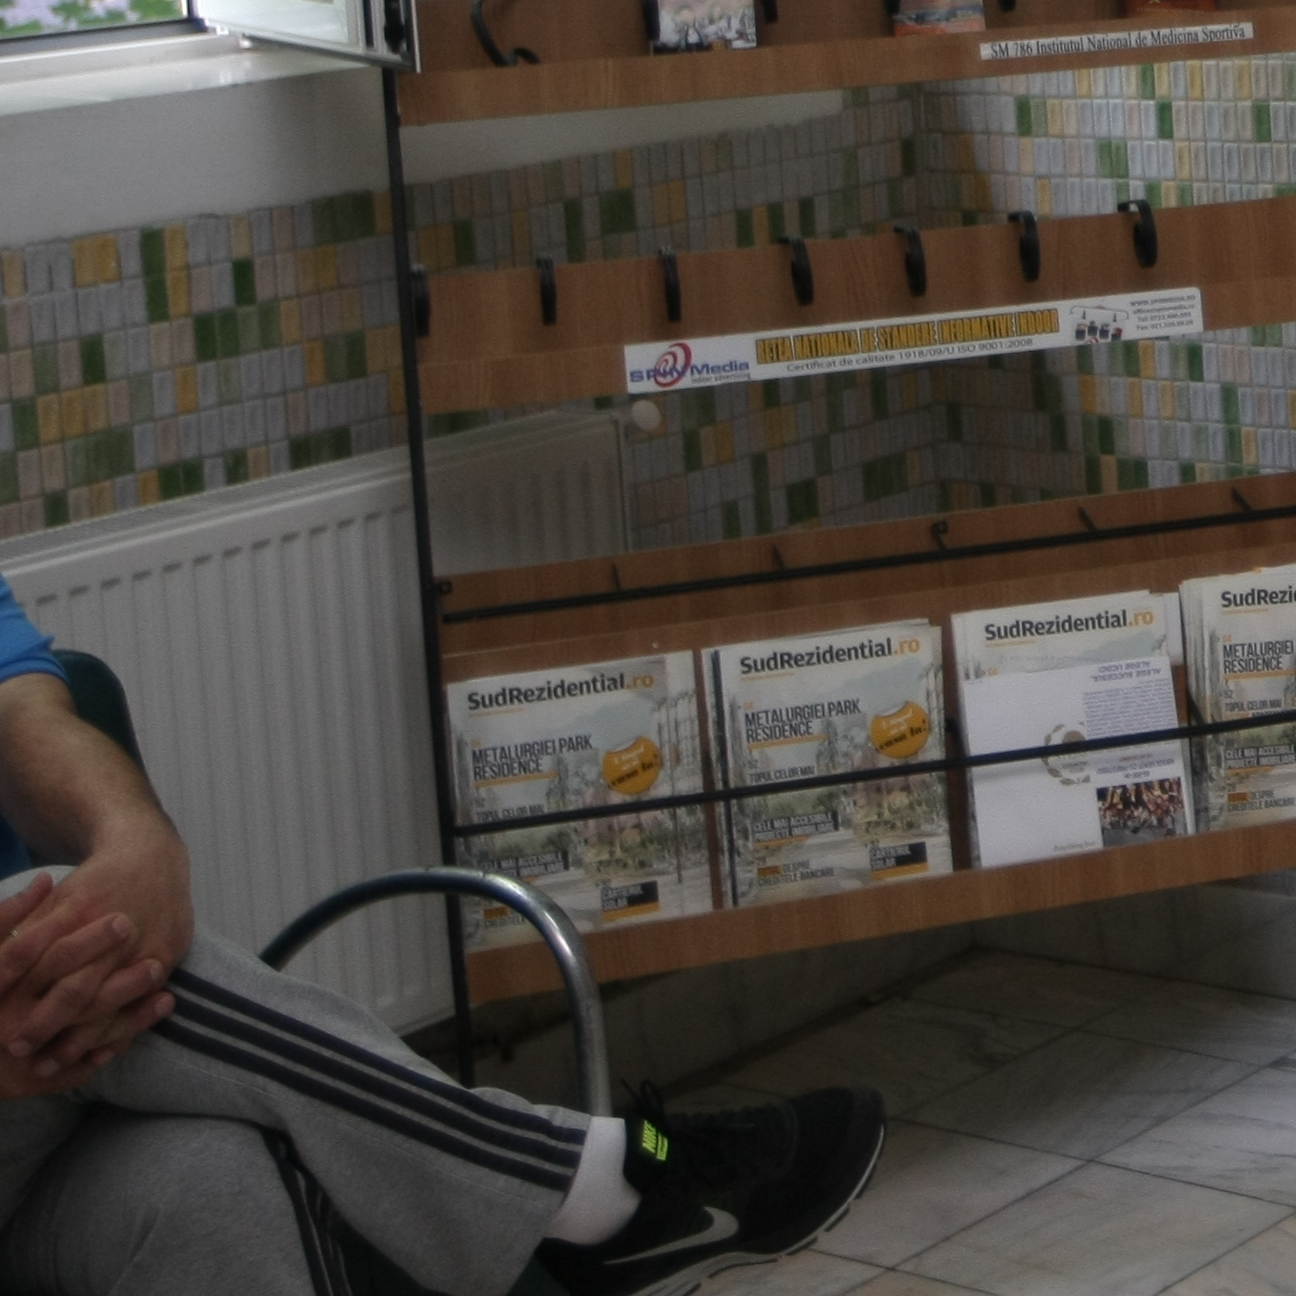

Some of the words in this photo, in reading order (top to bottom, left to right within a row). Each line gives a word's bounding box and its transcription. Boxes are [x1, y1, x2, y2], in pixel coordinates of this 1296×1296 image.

[990, 41, 1010, 60] SM
[1014, 40, 1033, 58] 786
[1036, 35, 1085, 56] Institutul
[1087, 30, 1132, 53] National
[1135, 29, 1148, 48] de
[1150, 25, 1200, 47] Medicina
[691, 359, 750, 376] Media
[786, 358, 836, 374] Certificat
[838, 356, 853, 368] de
[855, 351, 896, 365] calitate
[984, 608, 1155, 642] SudRezidential.ro
[740, 637, 922, 675] SudRezidential.ro
[1223, 639, 1296, 660] METALURGIEI
[1224, 654, 1283, 675] RESIDENCE
[467, 672, 655, 711] SudRezidential.ro
[745, 702, 825, 729] METALURGIEI
[827, 699, 862, 718] PARK
[746, 719, 814, 744] RESIDENCE
[471, 737, 556, 766] METALURGIEI
[558, 733, 594, 754] PARK
[473, 756, 545, 782] RESIDENCE
